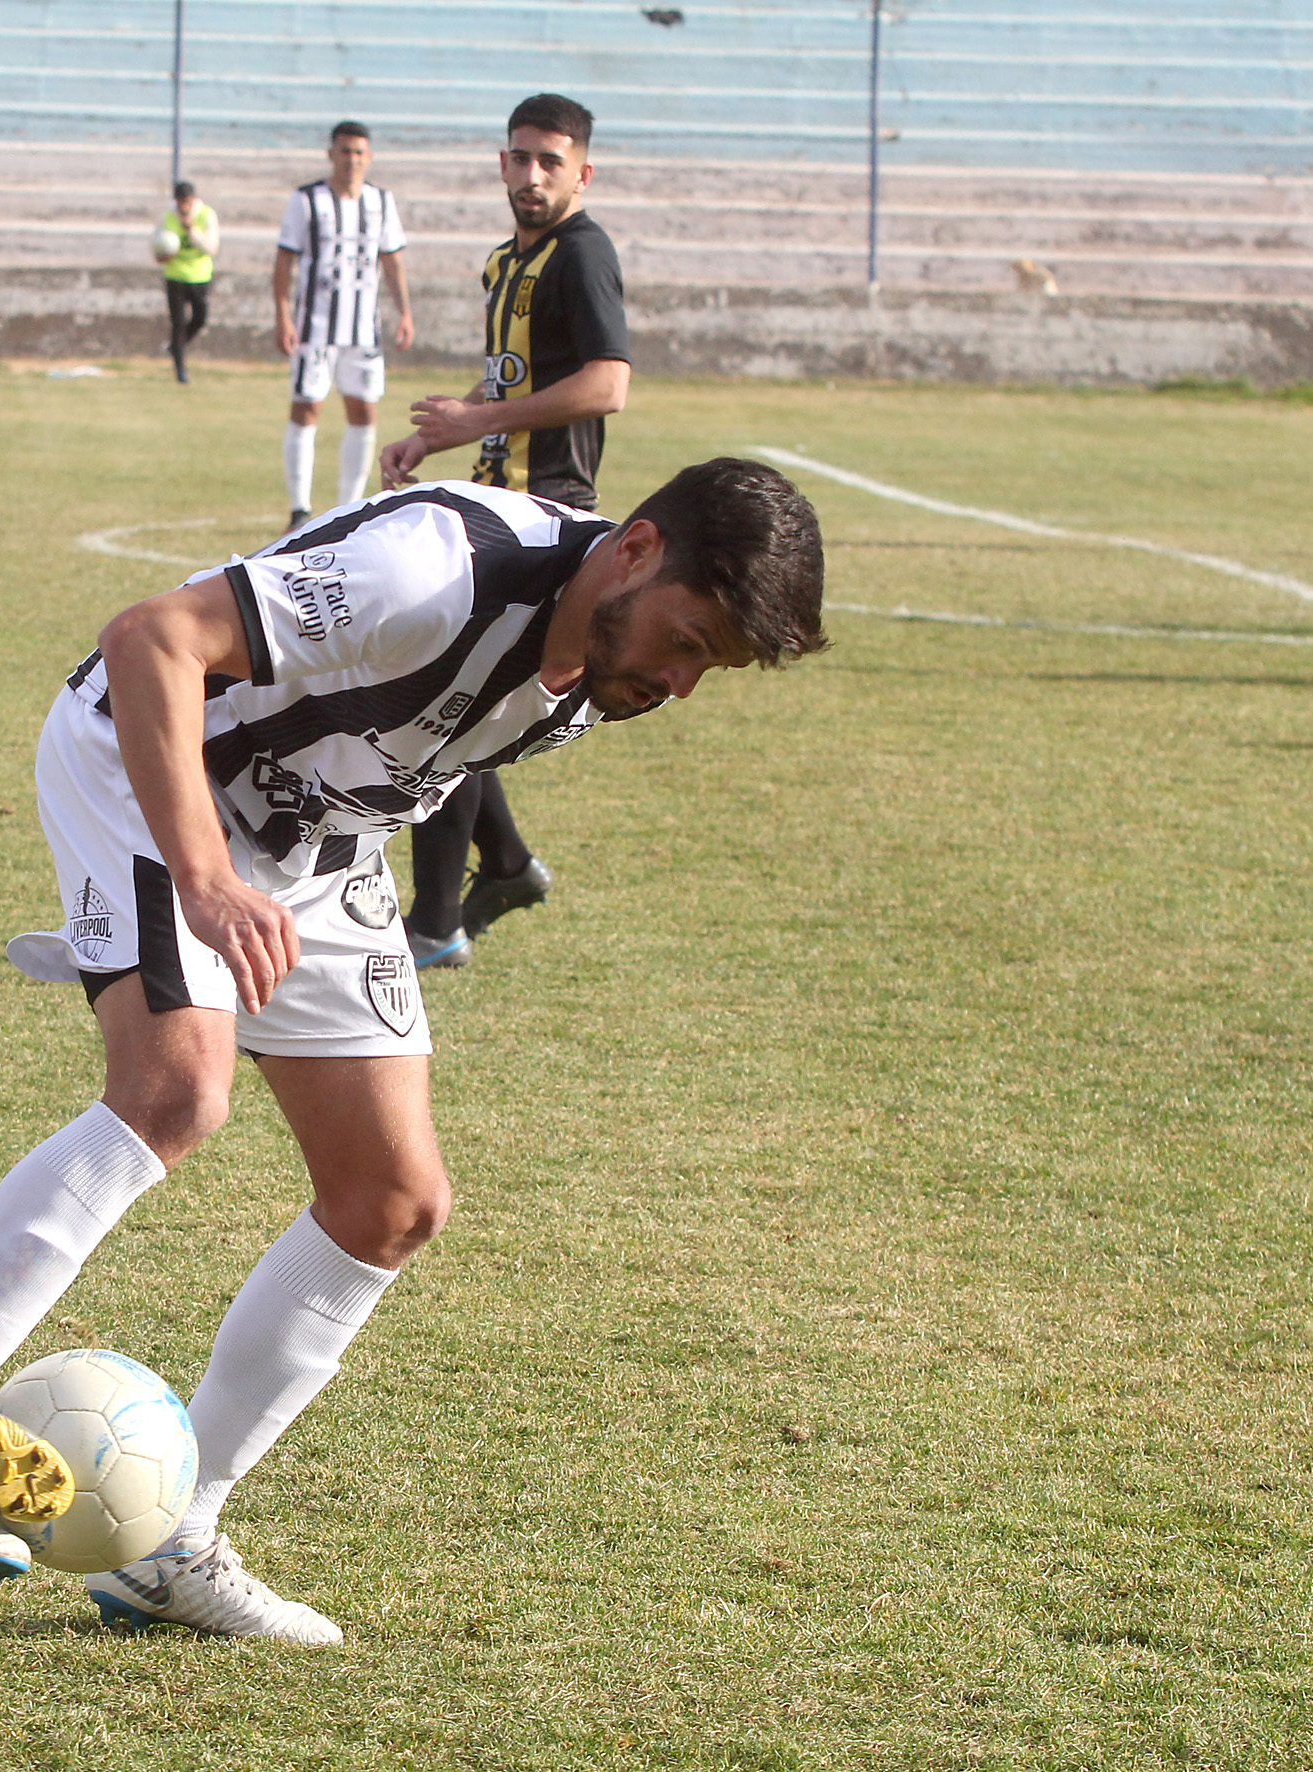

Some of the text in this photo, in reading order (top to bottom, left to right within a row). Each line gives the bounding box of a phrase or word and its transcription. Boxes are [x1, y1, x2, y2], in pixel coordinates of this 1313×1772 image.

[288, 577, 327, 642] Group
[318, 567, 353, 629] Trace
[414, 716, 455, 738] 1926
